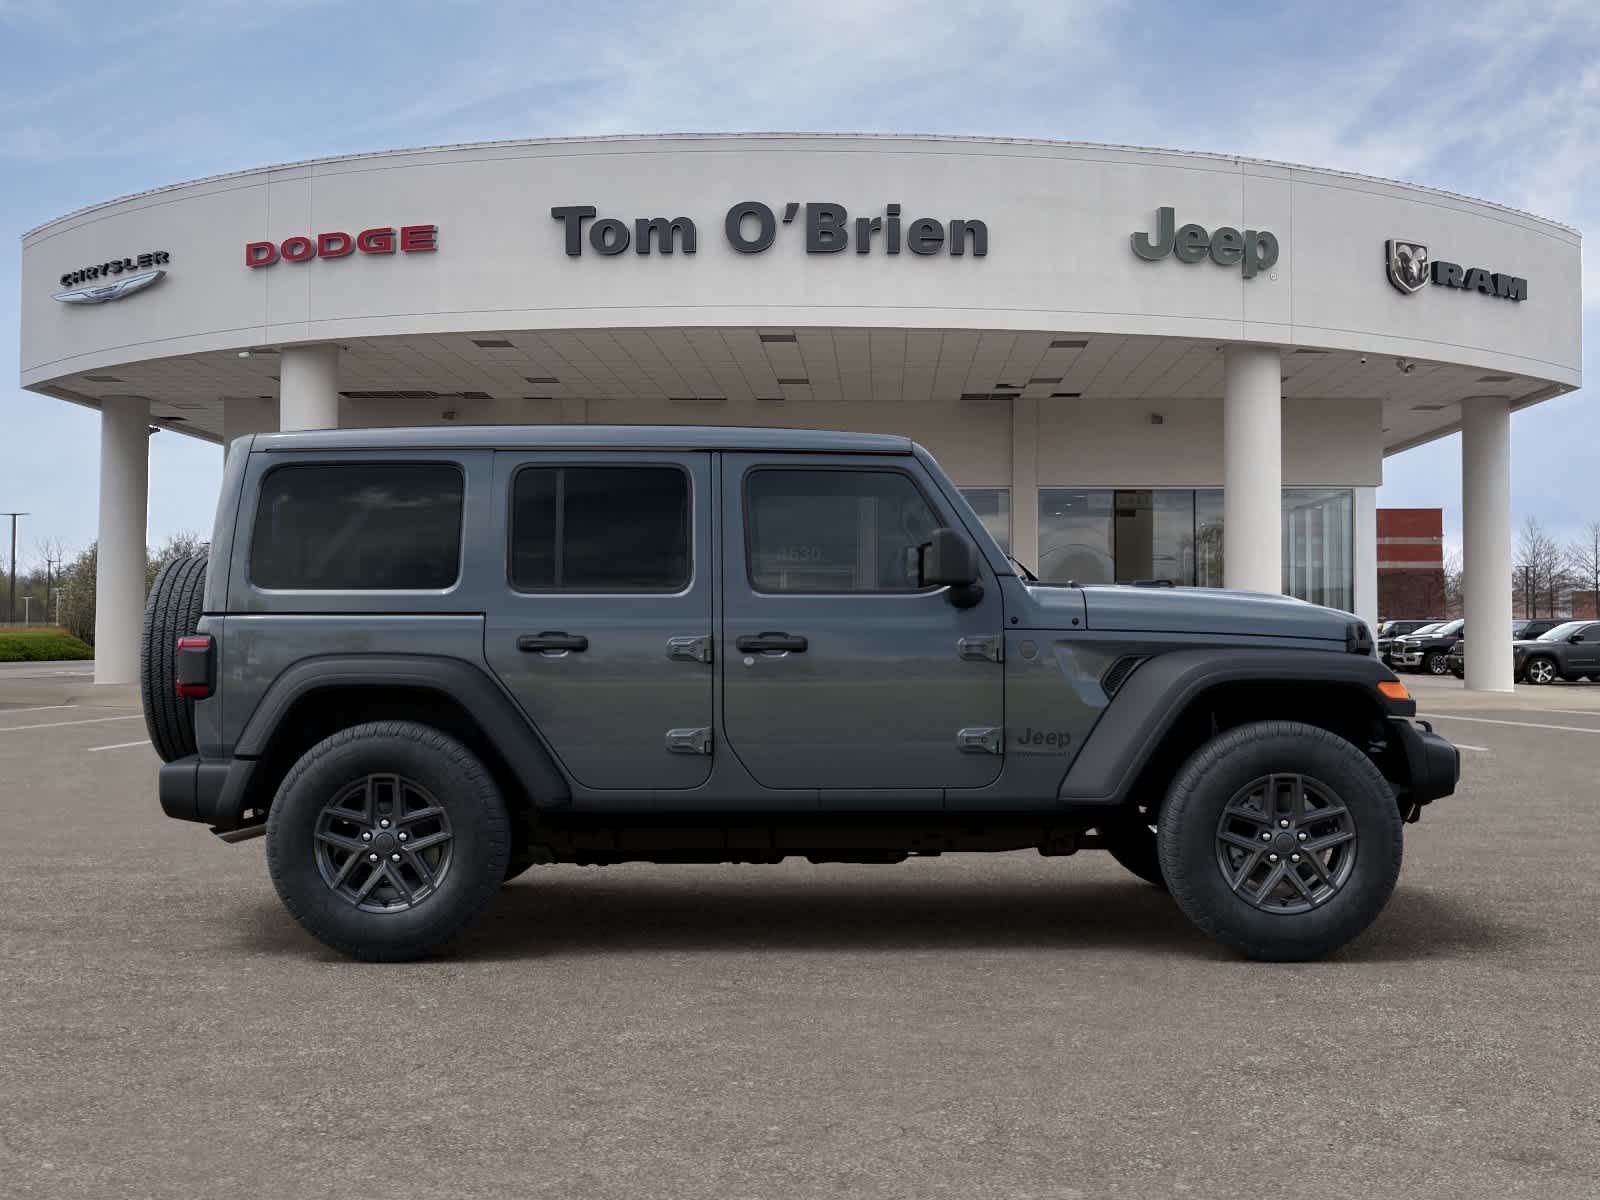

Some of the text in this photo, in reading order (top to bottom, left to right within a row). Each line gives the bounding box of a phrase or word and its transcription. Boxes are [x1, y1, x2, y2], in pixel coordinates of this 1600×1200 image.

[246, 225, 438, 268] DODGE
[551, 201, 988, 257] Tom O'Brien
[1130, 206, 1280, 279] Jeep
[60, 250, 170, 286] CHRYSLER
[1430, 260, 1528, 301] RAM
[1017, 727, 1072, 749] Jeep
